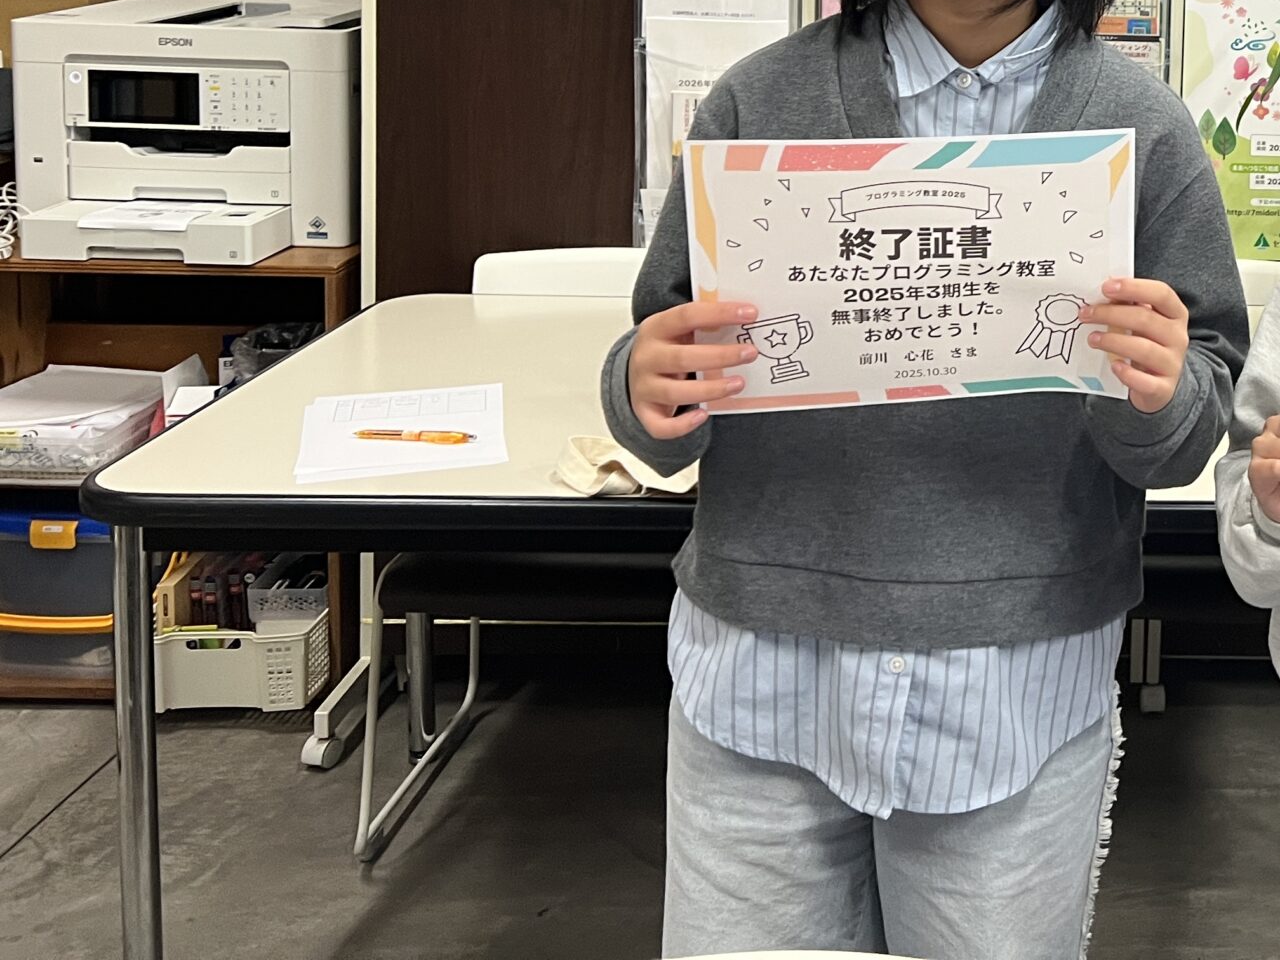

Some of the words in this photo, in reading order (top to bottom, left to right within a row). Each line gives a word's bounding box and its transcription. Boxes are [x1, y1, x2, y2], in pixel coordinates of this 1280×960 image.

[158, 37, 193, 47] EPSON
[866, 189, 939, 201] プログラミング教室
[942, 190, 966, 198] 2025
[838, 225, 992, 262] 終了証書
[787, 259, 1056, 283] あたなたプログラミング教室
[843, 280, 1001, 304] 2025年3期生を
[831, 302, 1005, 326] 無事終了しました。
[864, 322, 979, 343] おめでとう！
[859, 352, 888, 365] 前川
[904, 348, 934, 362] 心花
[950, 346, 977, 359] さま
[894, 366, 957, 379] 2025.10.30
